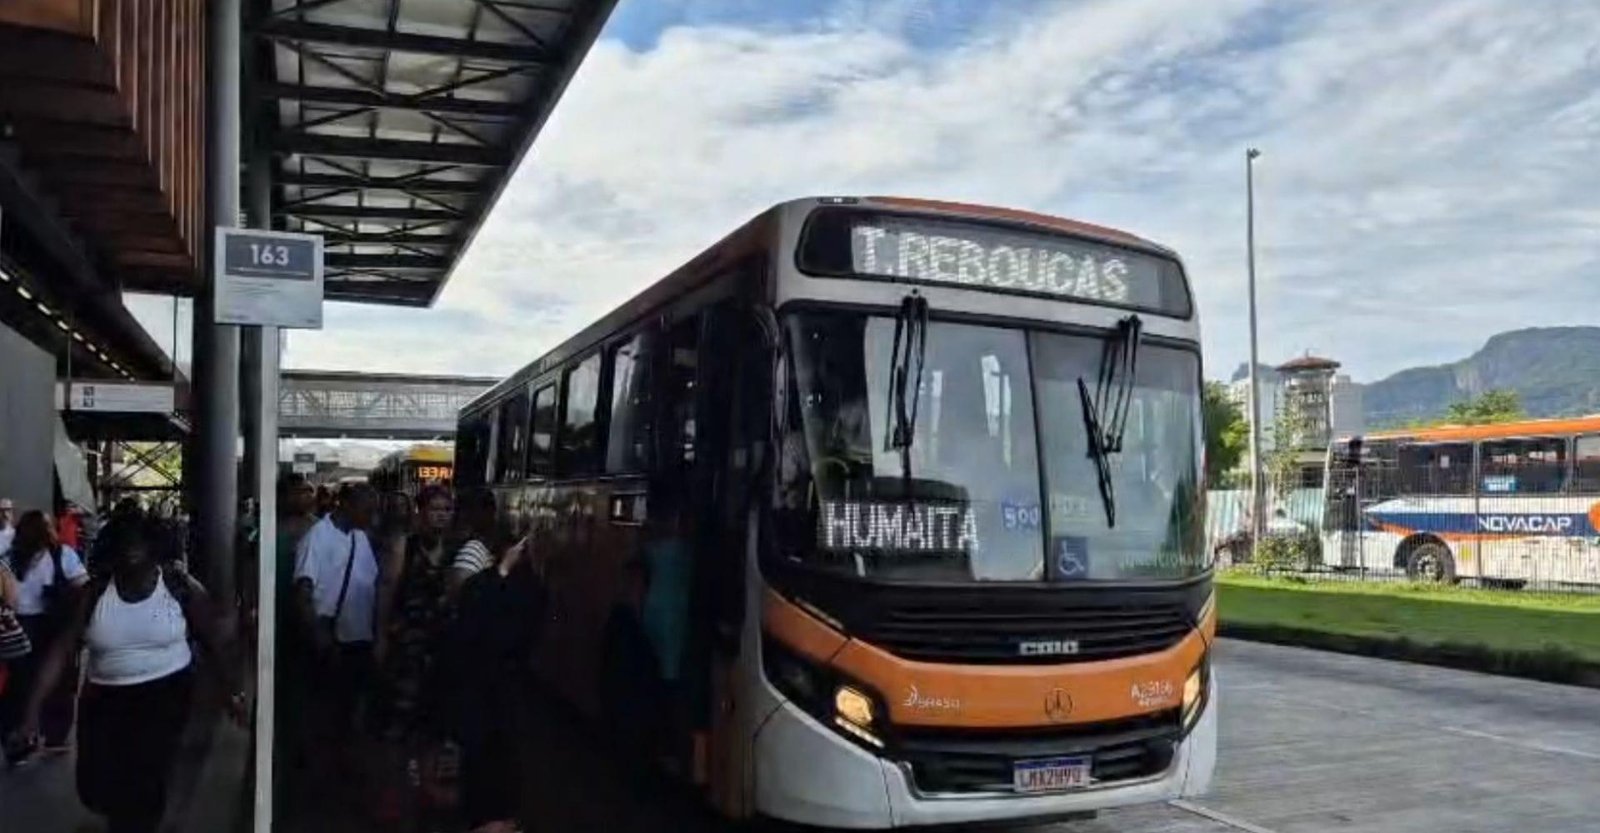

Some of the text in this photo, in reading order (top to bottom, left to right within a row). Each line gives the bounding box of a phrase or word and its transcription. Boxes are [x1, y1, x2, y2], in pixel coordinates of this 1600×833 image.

[251, 244, 289, 266] 163
[826, 502, 979, 550] HUMAITA
[1478, 516, 1572, 531] NOVACAP
